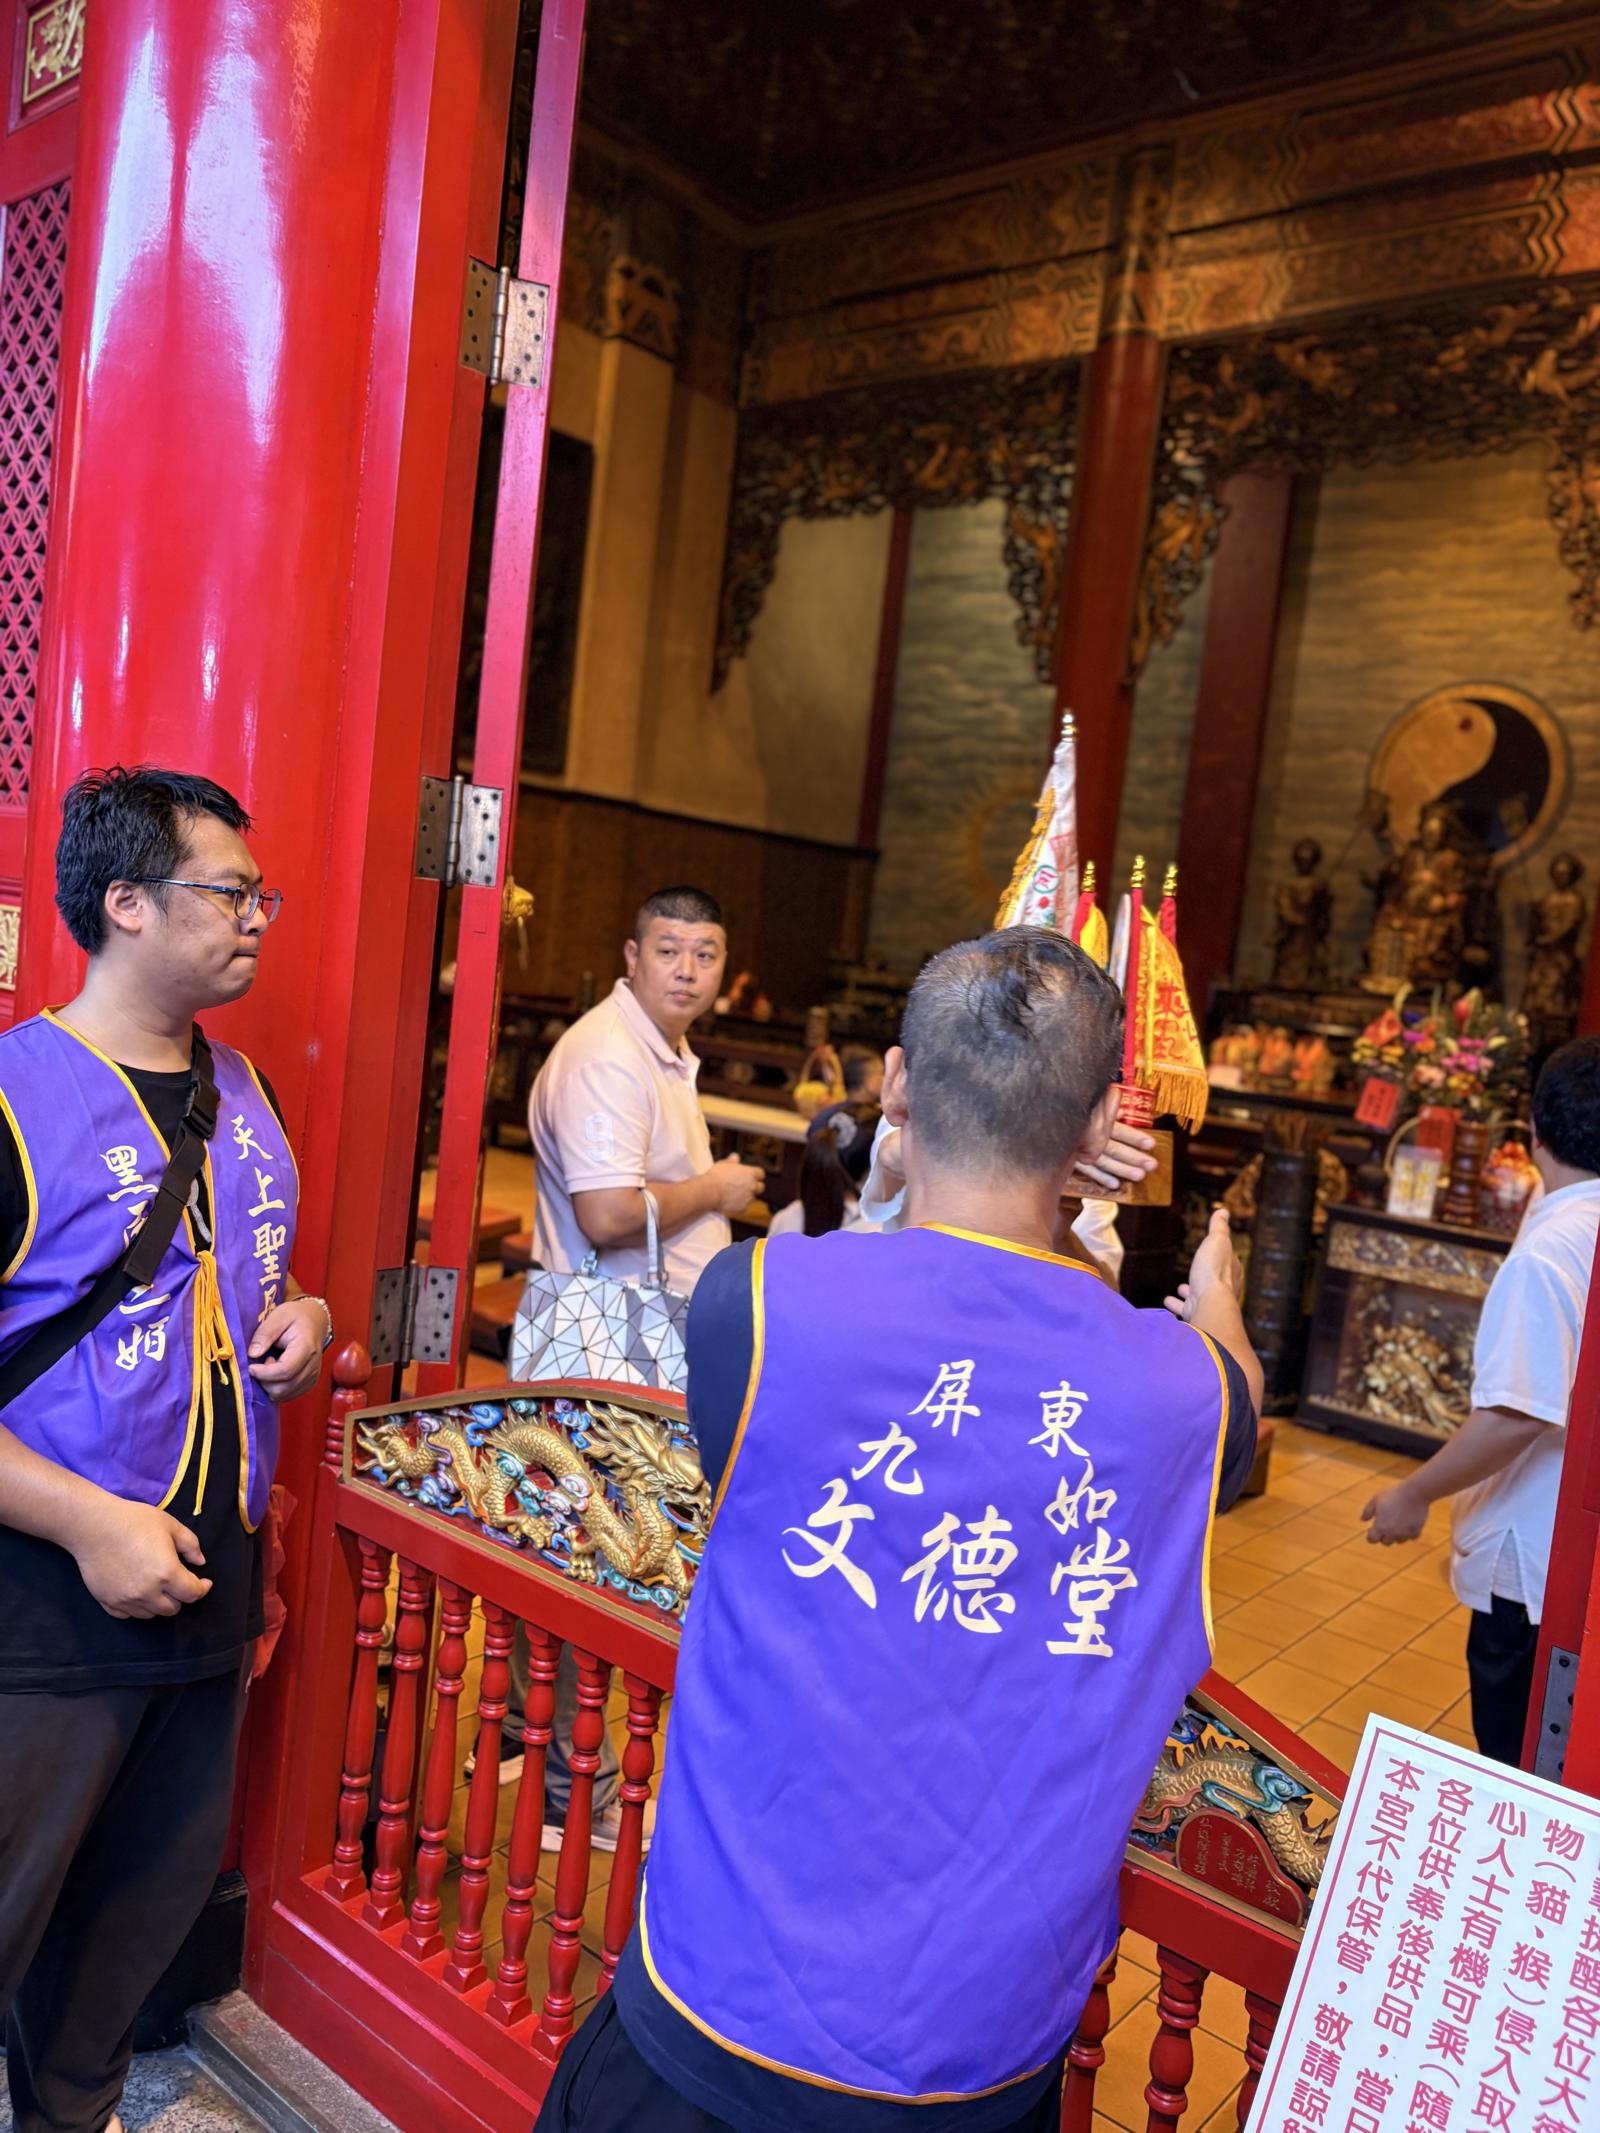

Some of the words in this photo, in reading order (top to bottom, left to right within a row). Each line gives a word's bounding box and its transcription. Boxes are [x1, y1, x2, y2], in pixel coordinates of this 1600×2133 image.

[1404, 1800, 1527, 2133] 心人士有機可乘（隨
